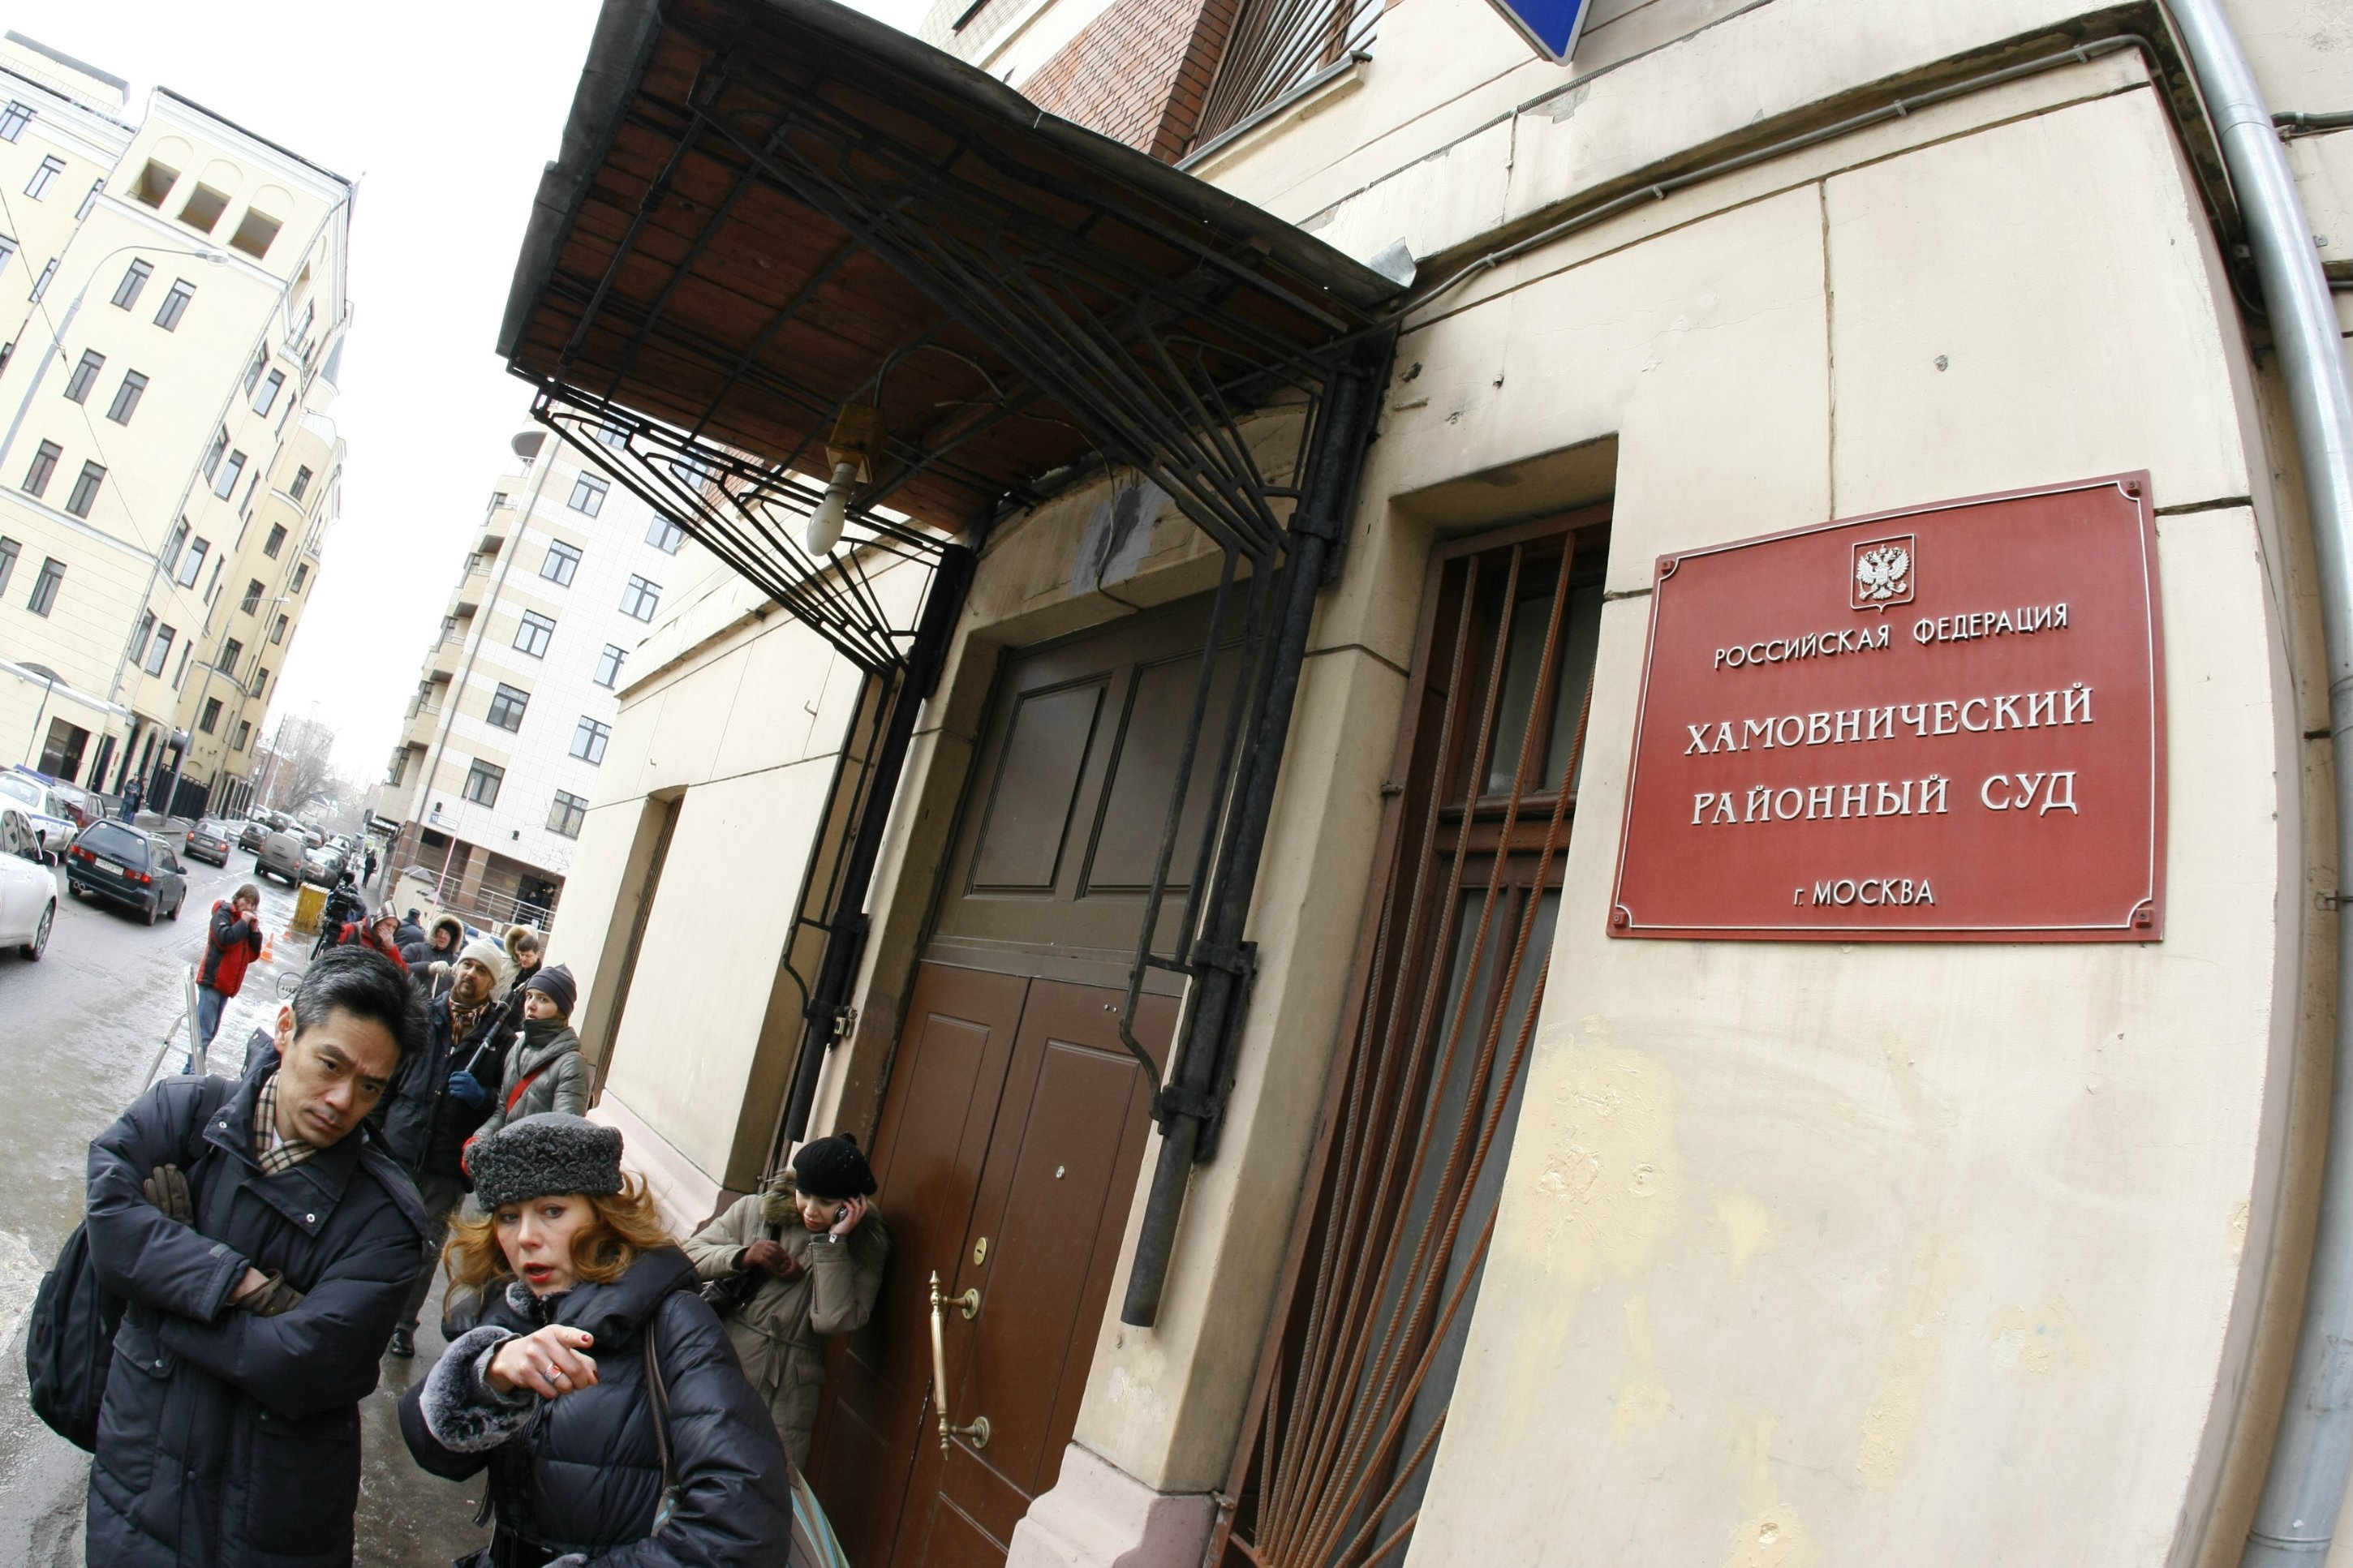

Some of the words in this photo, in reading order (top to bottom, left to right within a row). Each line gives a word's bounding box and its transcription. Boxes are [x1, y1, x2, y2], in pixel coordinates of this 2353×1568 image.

[1714, 625, 1890, 668] РОССИЙСКАЯ
[1913, 604, 2067, 645] ФЕДЕРАЦИЯ
[1684, 682, 2093, 754] ХАМОВНИЧЕСКИЙ
[1691, 774, 1949, 824] РАЙОННЫЙ
[1981, 771, 2078, 816] СУД
[1793, 888, 1805, 906] г.
[1812, 879, 1934, 905] МОСКВА
